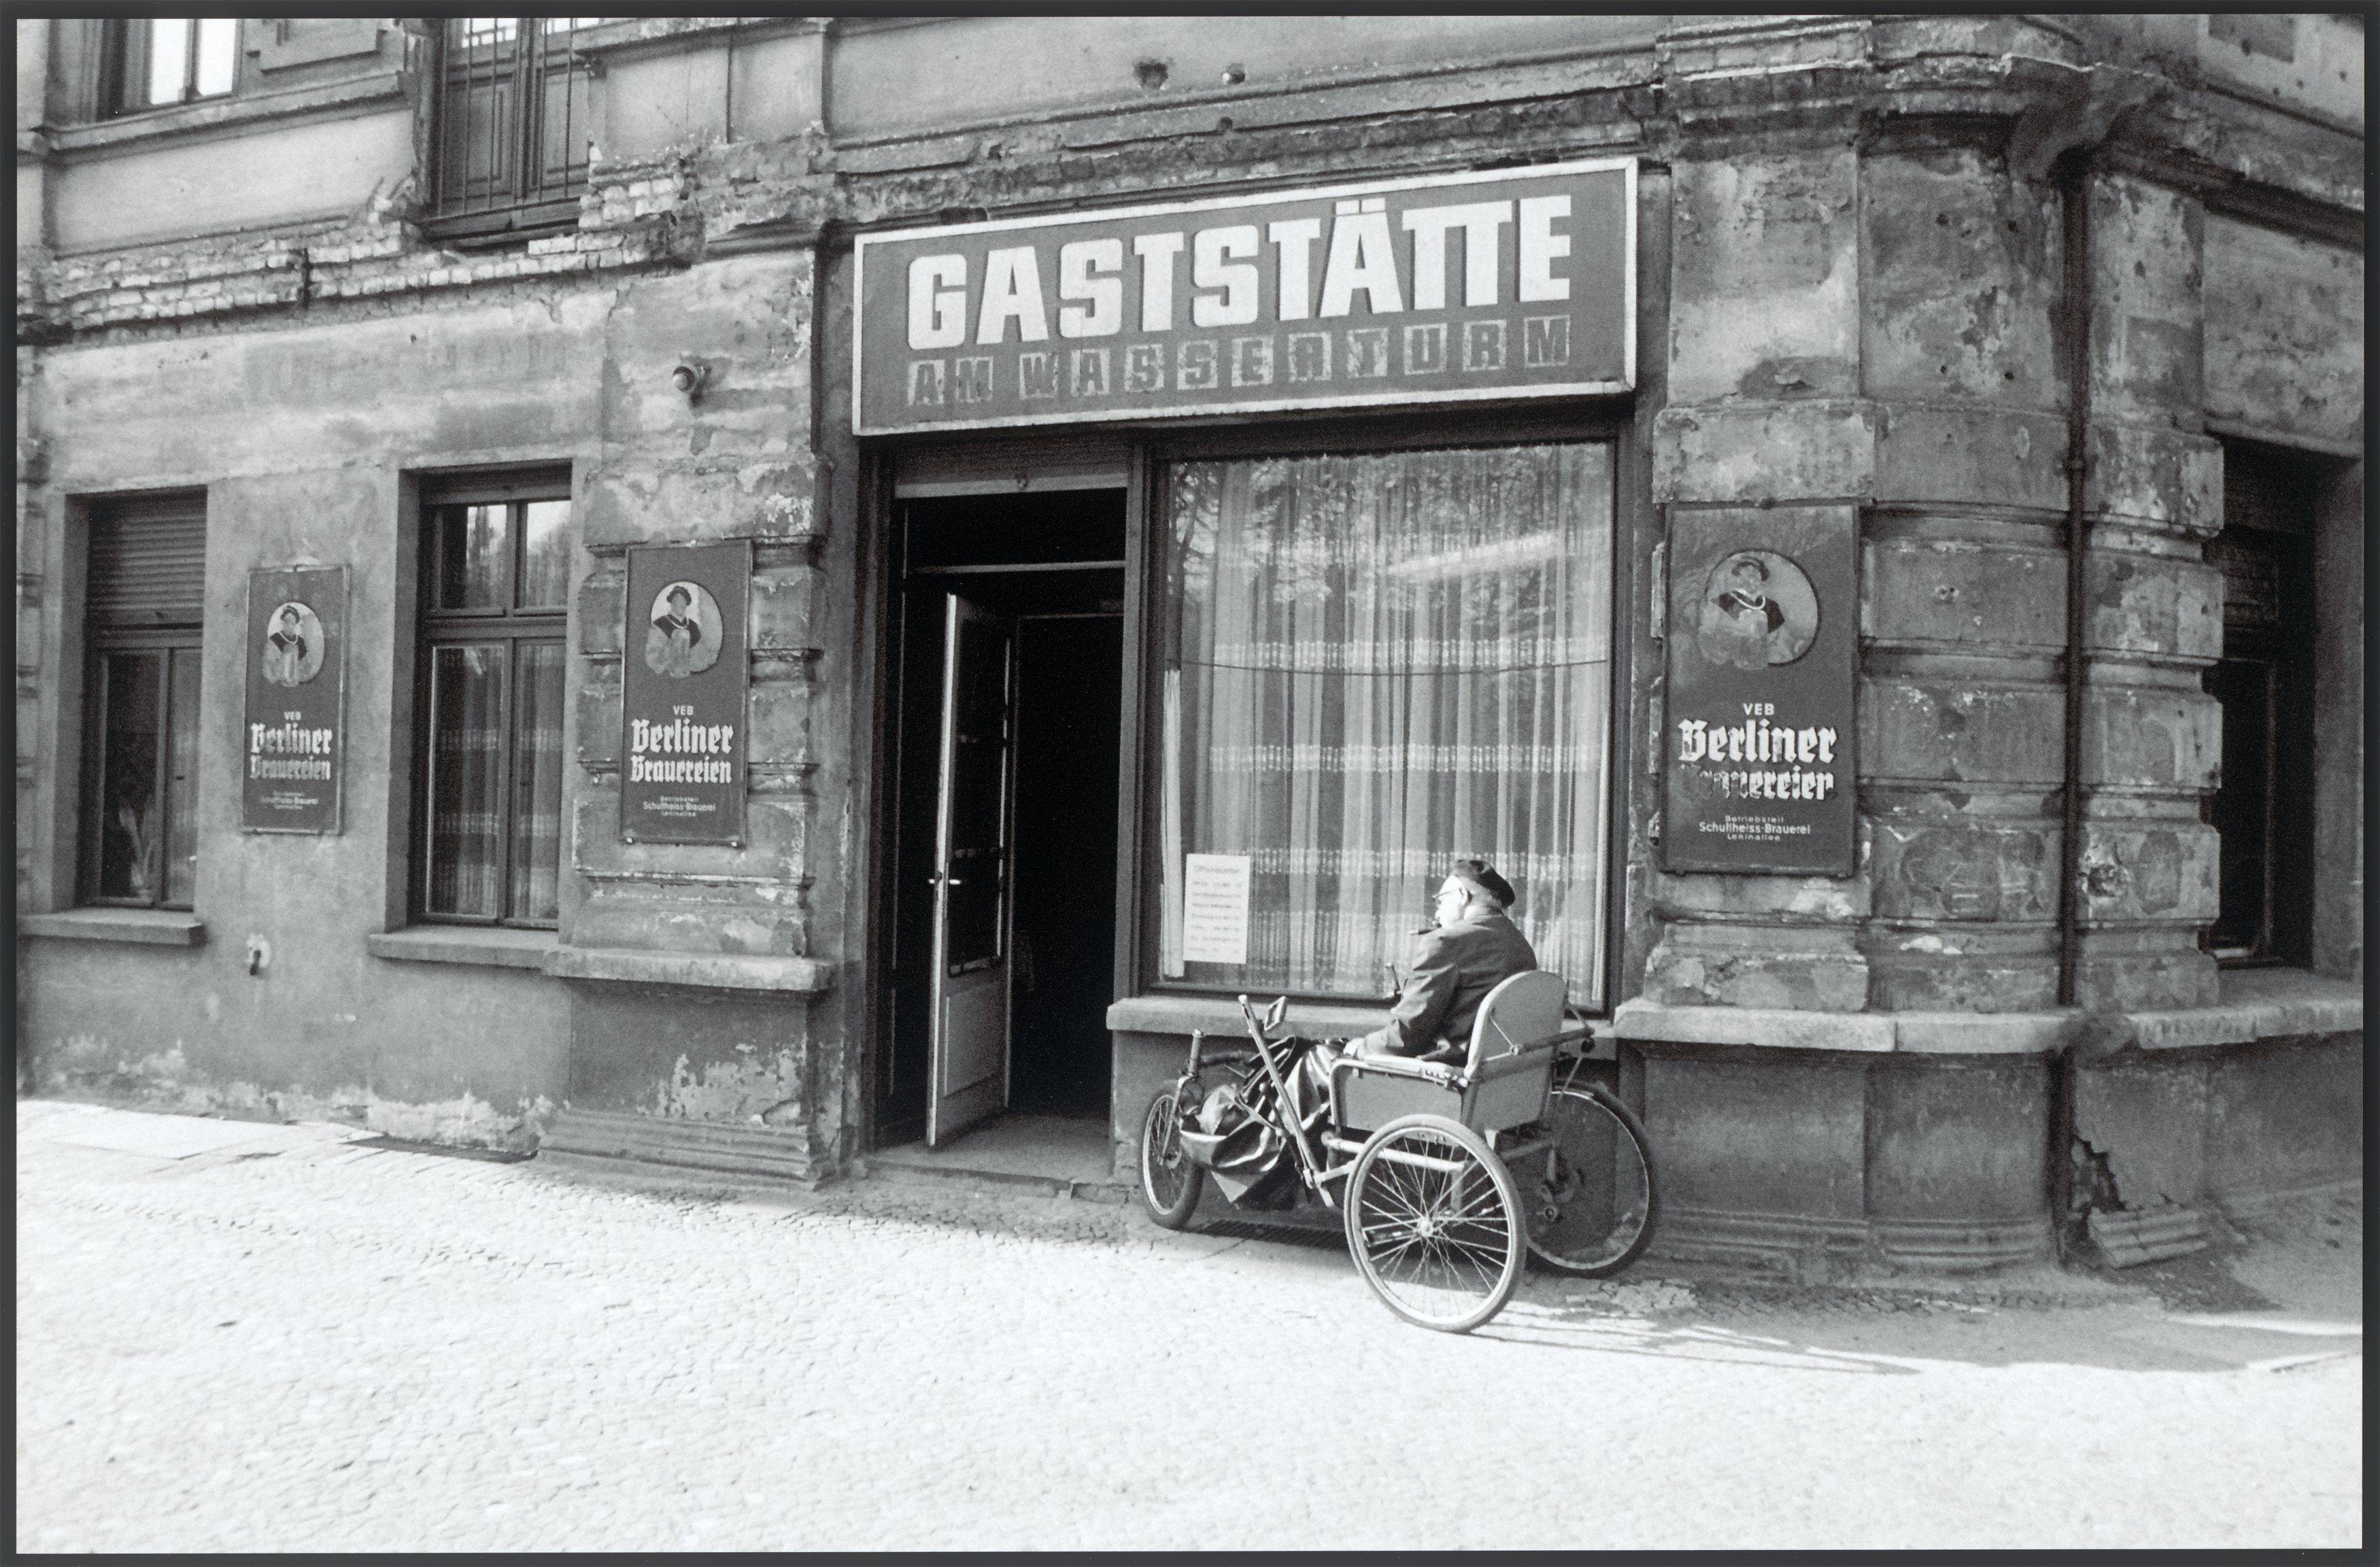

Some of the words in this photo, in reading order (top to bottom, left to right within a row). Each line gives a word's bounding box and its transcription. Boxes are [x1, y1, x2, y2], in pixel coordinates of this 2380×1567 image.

[907, 195, 1572, 349] GASTSTÄTTE
[908, 356, 993, 406] AM
[1019, 314, 1571, 400] WASSERTURM
[284, 711, 302, 721] VEB
[673, 705, 694, 715] VEB
[1743, 703, 1775, 715] VEB
[250, 723, 333, 755] Berliner
[631, 717, 734, 754] Berliner
[1678, 718, 1837, 763] Berliner
[630, 755, 732, 783] Brauereien
[1699, 821, 1811, 835] Schultheiss-Brauerei
